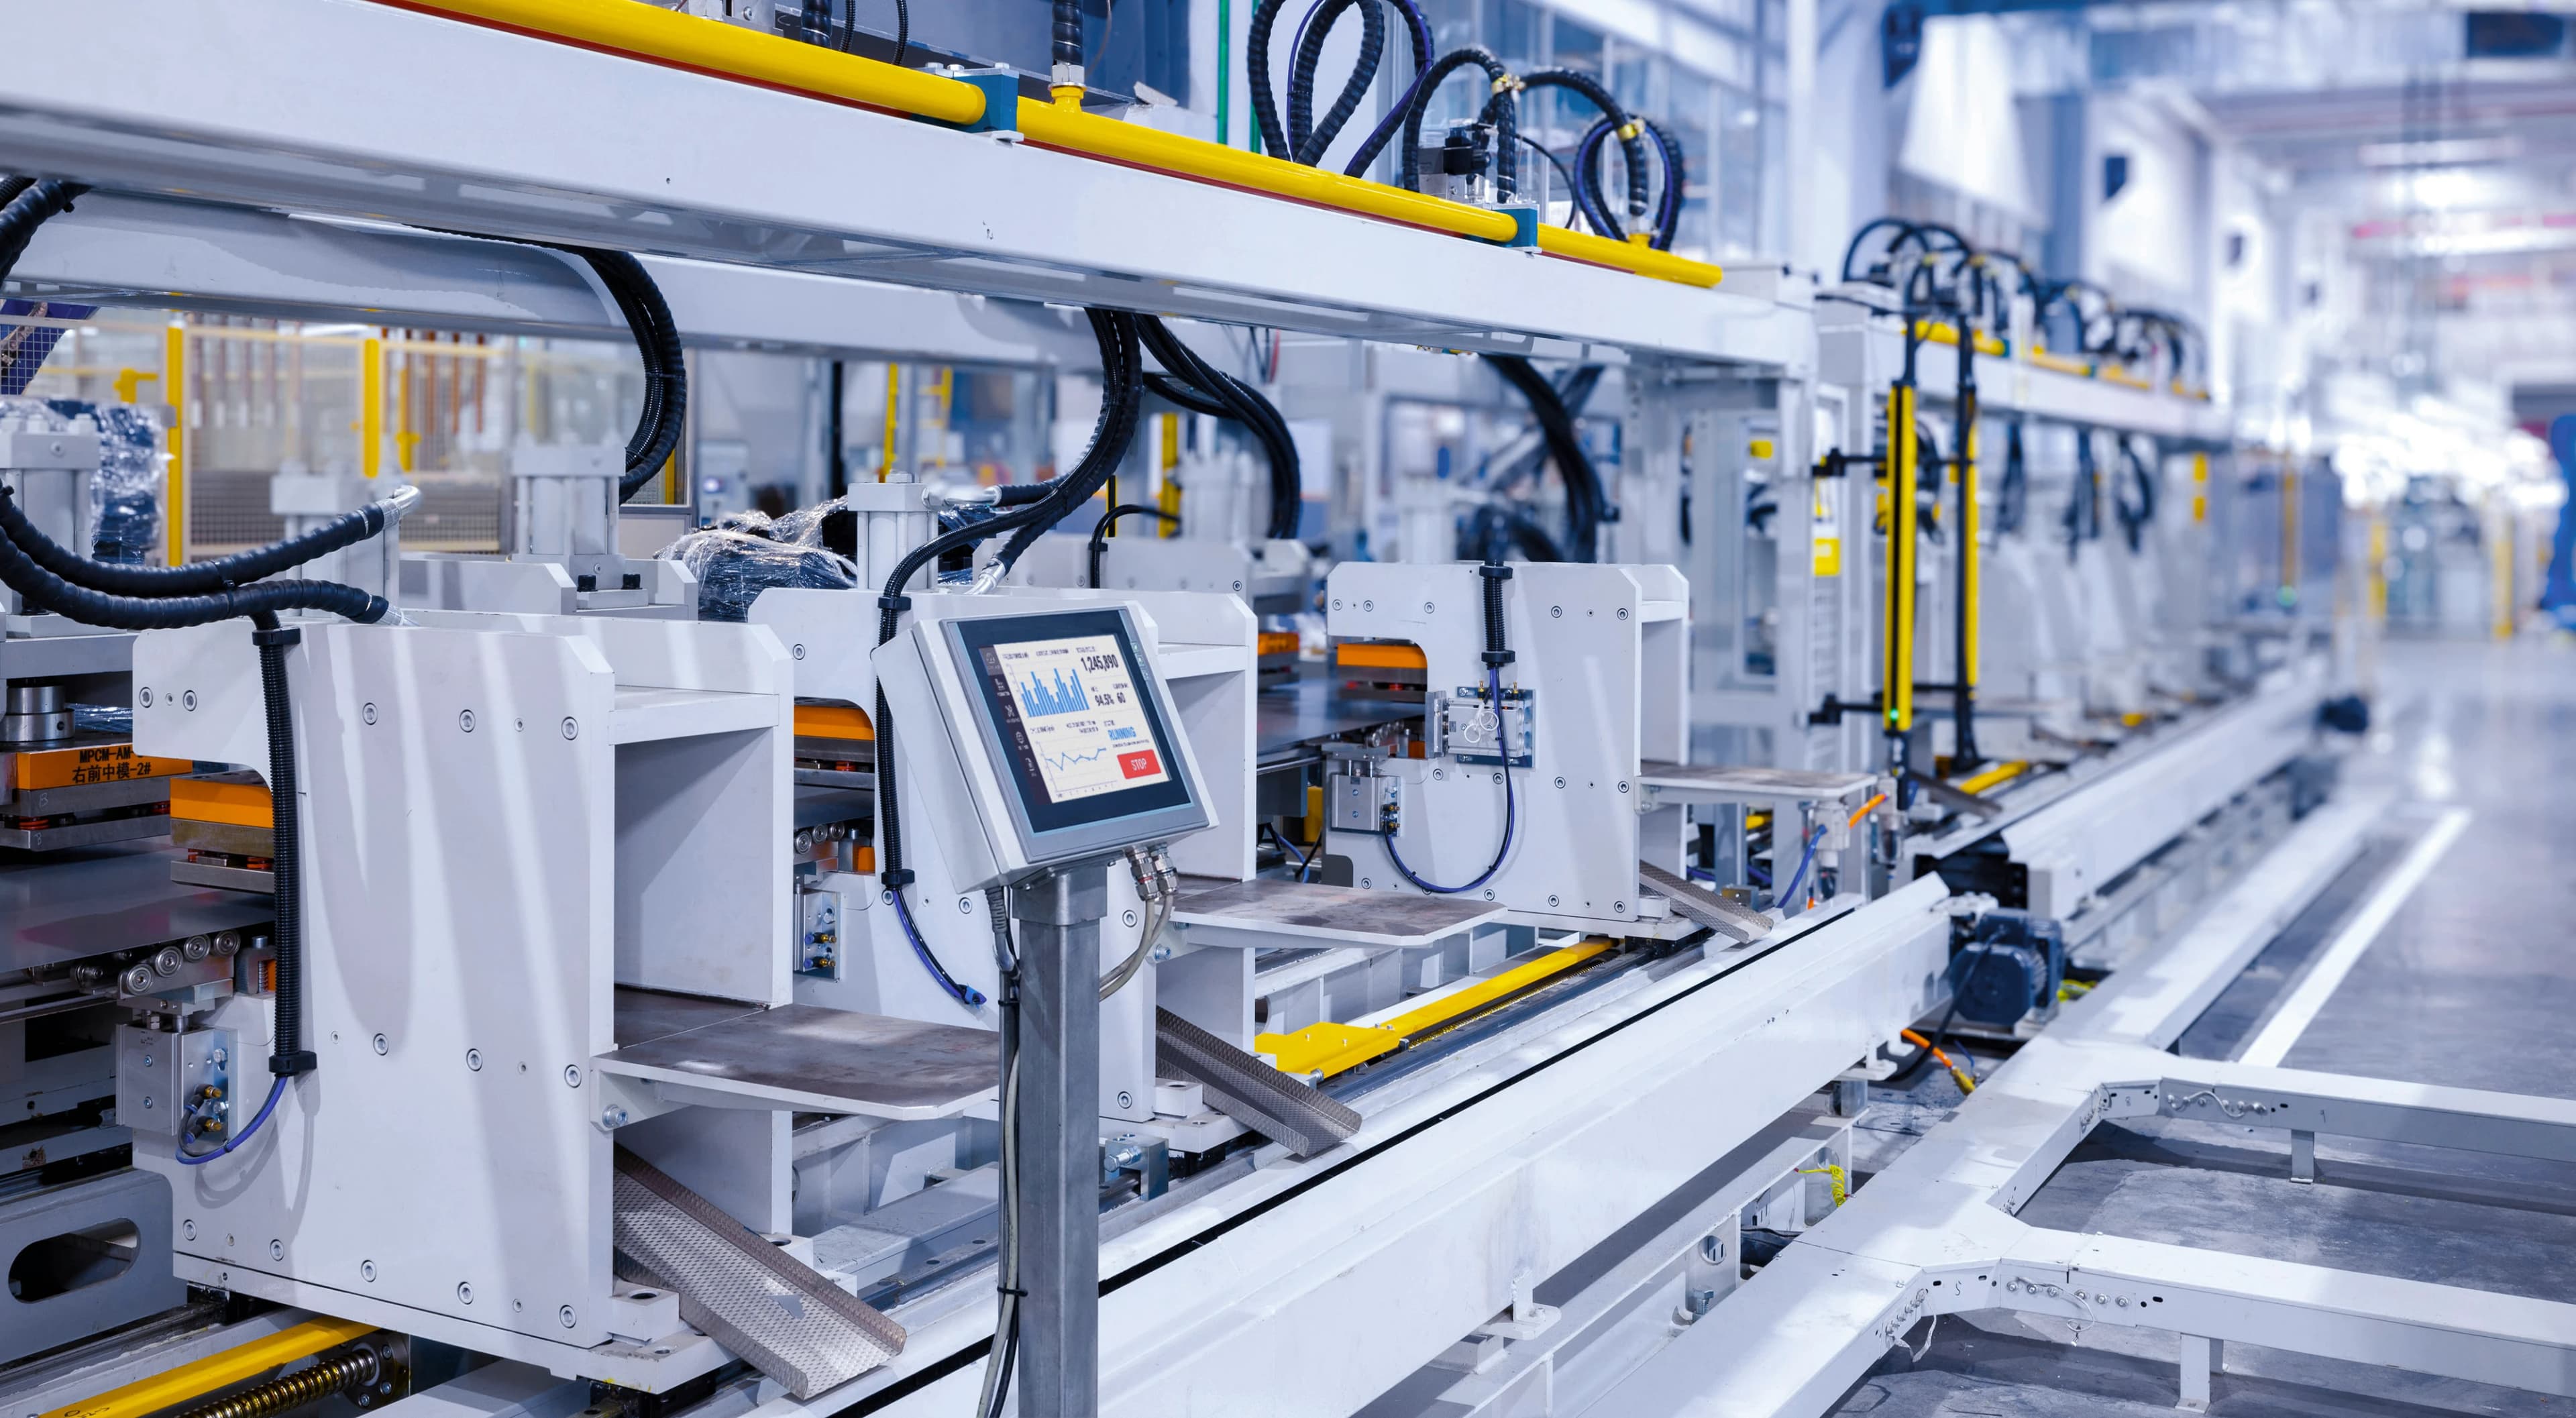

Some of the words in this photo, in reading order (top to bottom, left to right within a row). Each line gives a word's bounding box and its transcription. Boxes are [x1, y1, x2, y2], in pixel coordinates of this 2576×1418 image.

[1081, 654, 1119, 673] 1,245,890
[1095, 694, 1114, 706] 94.5%
[1117, 692, 1126, 704] 60
[1108, 726, 1137, 741] RUNNING
[79, 747, 143, 763] MPCM-AM-
[1130, 758, 1147, 771] STOP
[72, 762, 151, 783] 右前中模-2#
